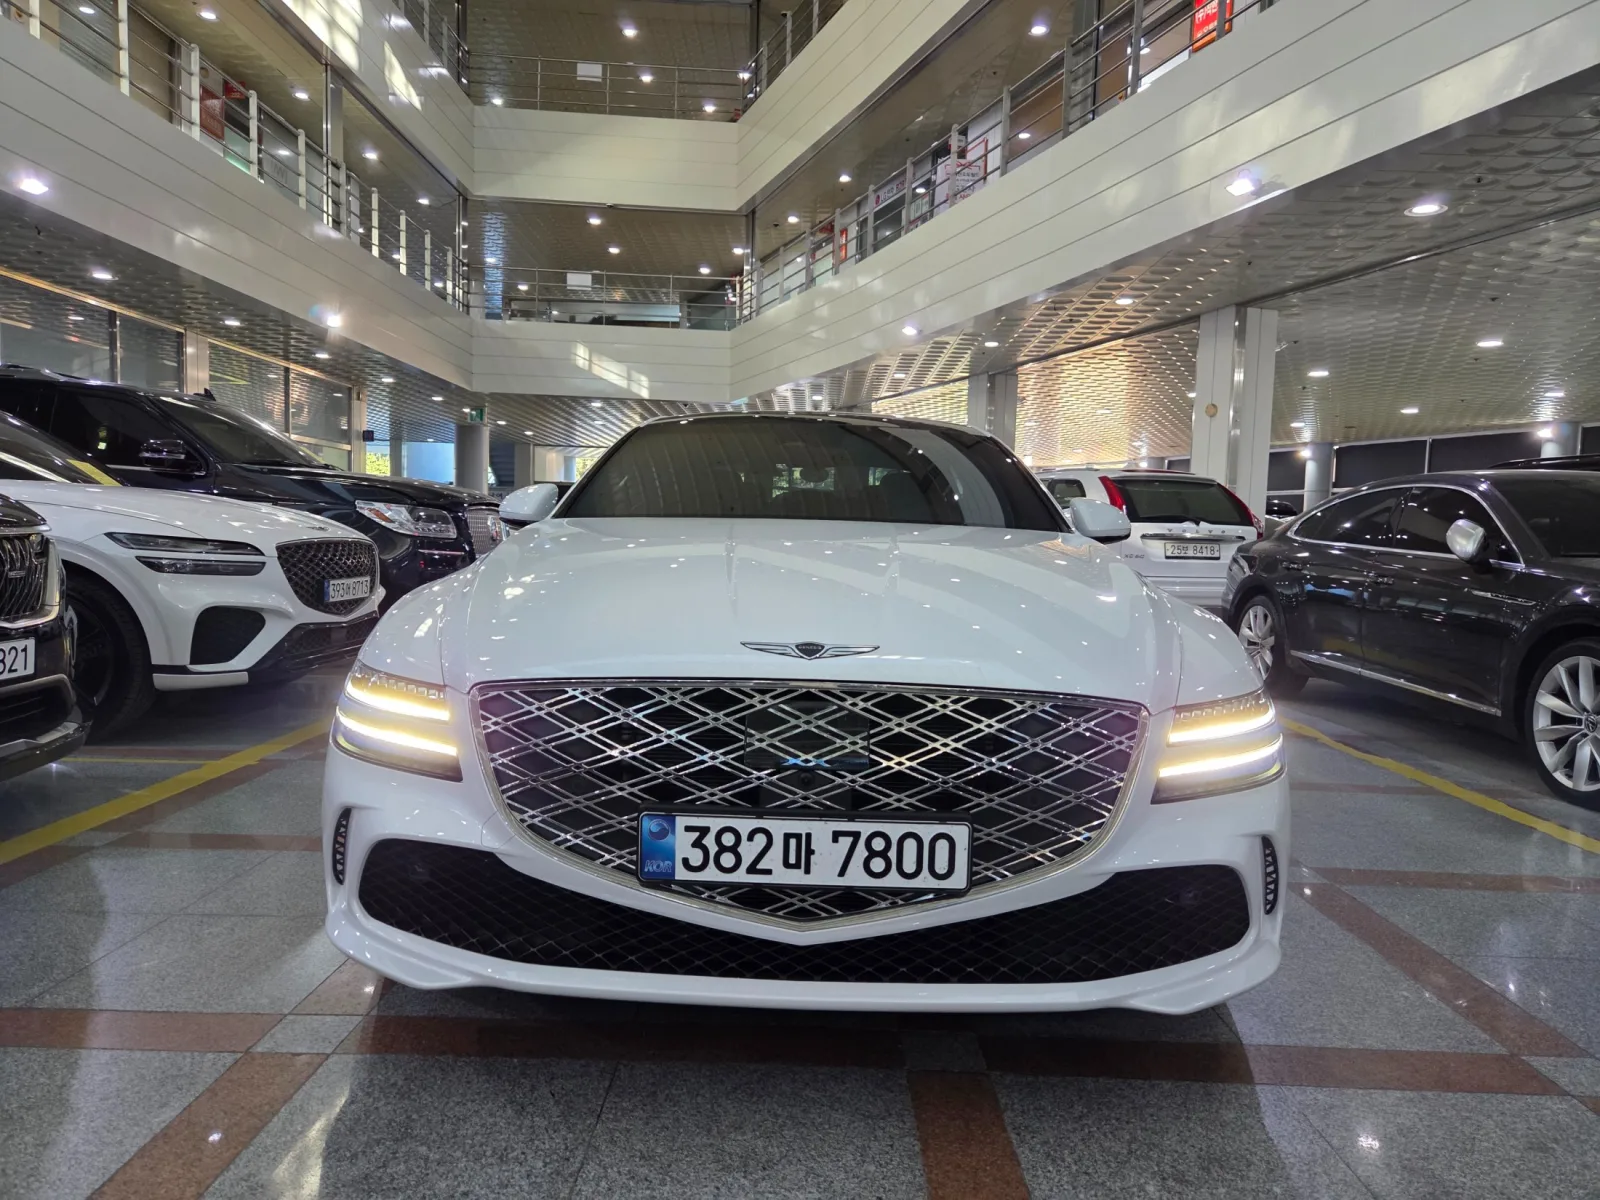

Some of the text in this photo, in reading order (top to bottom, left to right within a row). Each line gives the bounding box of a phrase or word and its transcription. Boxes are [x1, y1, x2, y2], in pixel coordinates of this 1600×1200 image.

[1192, 545, 1216, 556] 8418
[351, 579, 369, 596] 8713
[681, 825, 957, 881] 382마 7800
